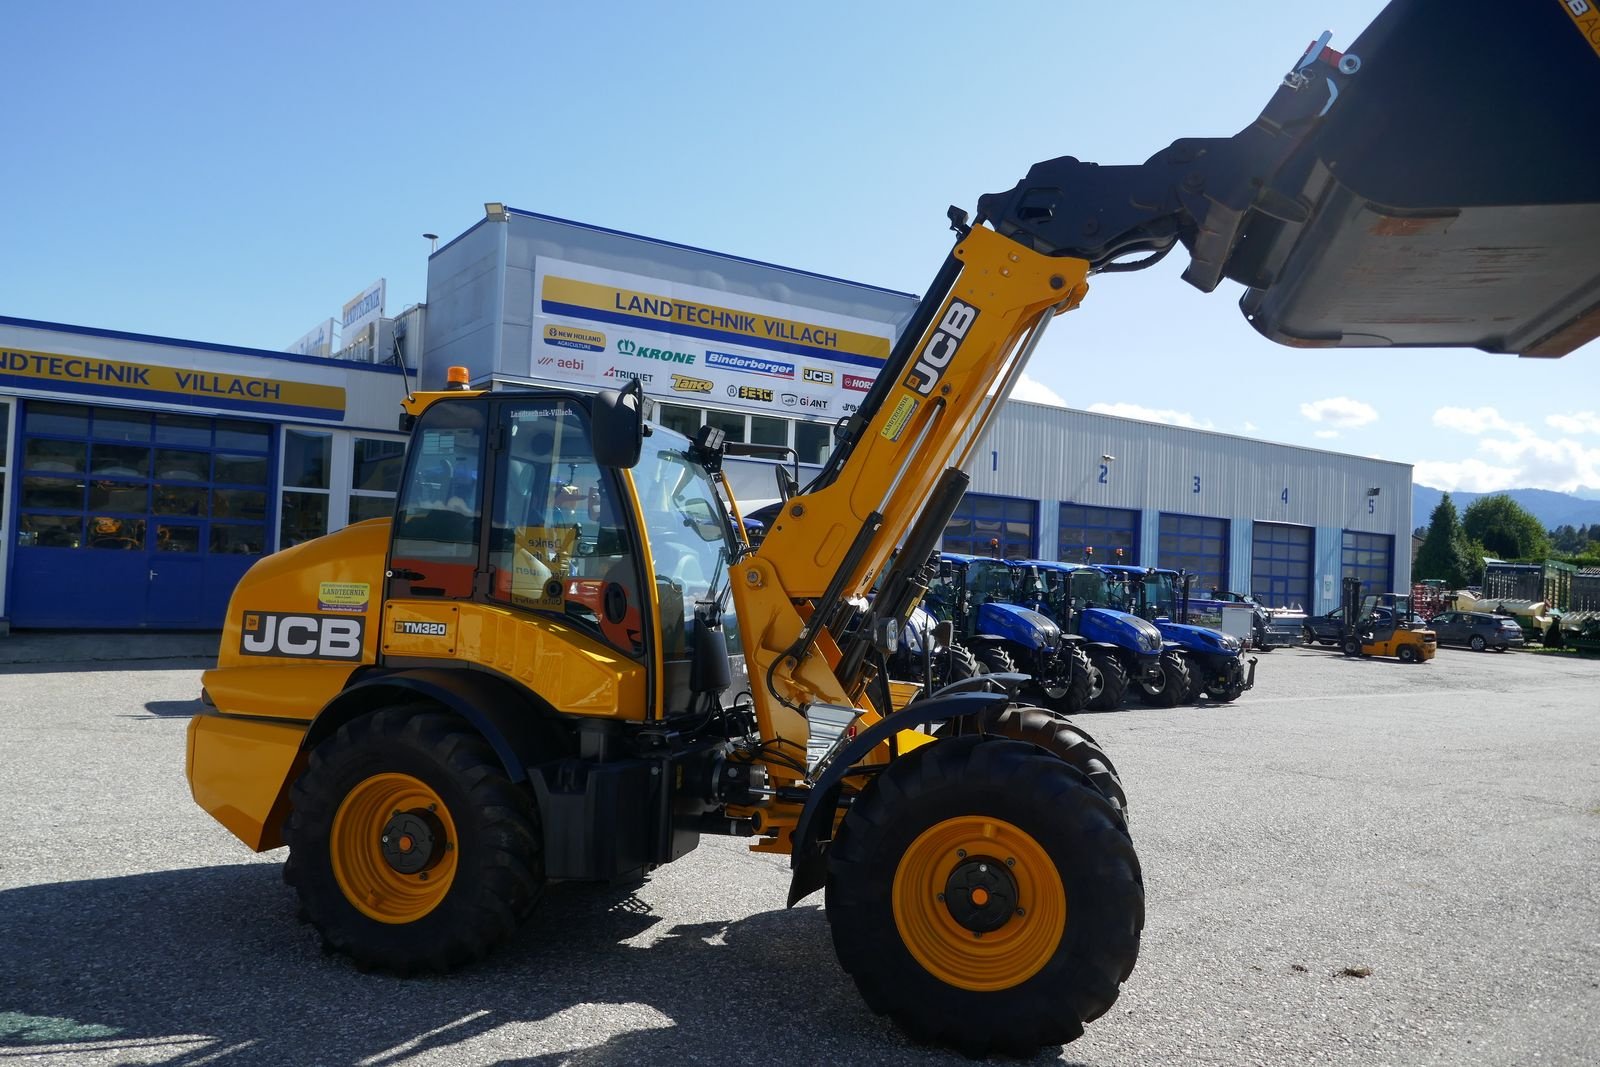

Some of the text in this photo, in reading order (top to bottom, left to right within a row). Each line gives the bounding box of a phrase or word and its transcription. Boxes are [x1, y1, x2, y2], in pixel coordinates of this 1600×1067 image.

[615, 292, 837, 348] LANDTECHNIK VILLACH
[573, 333, 602, 343] HOLLAND
[636, 346, 697, 365] KRONE
[915, 302, 976, 394] JCB
[557, 359, 584, 371] aebi
[708, 352, 794, 374] Binderberger
[614, 369, 654, 383] TRIQUET
[670, 373, 715, 394] Tanco
[803, 369, 833, 384] JCB
[175, 371, 281, 400] VILLACH
[991, 451, 998, 471] 1
[1098, 464, 1108, 484] 2
[1193, 476, 1201, 493] 3
[1281, 487, 1289, 504] 4
[1368, 498, 1375, 515] 5
[322, 588, 365, 596] LANDTECHNIK
[244, 615, 361, 657] JCB
[404, 622, 446, 635] TM320
